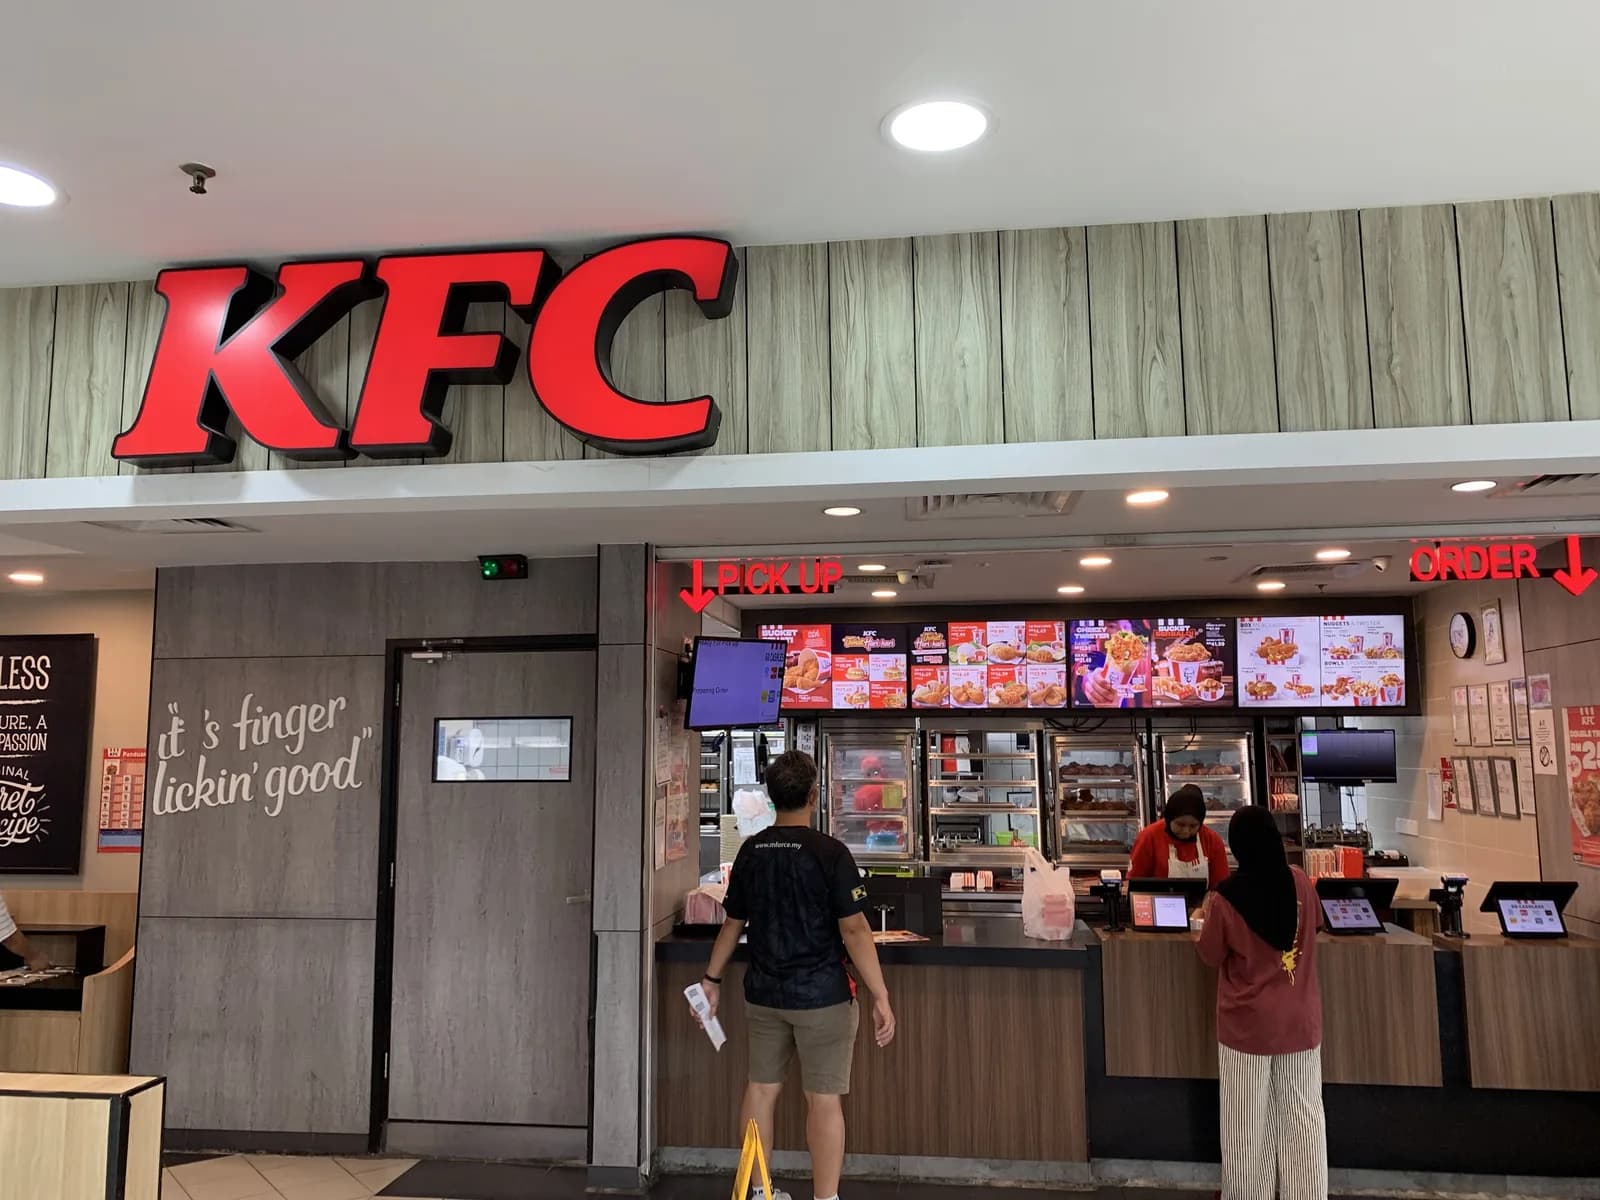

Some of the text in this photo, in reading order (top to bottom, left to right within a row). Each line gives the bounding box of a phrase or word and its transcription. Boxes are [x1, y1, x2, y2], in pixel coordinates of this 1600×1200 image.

[111, 236, 737, 468] KFC
[1411, 543, 1540, 581] ORDER
[718, 561, 843, 595] PICK UP
[762, 629, 798, 637] BUCKET
[36, 715, 48, 729] A
[232, 693, 346, 755] finger
[1581, 716, 1596, 725] KFC
[0, 733, 48, 751] PASSION
[755, 841, 802, 850] www.mforce.my
